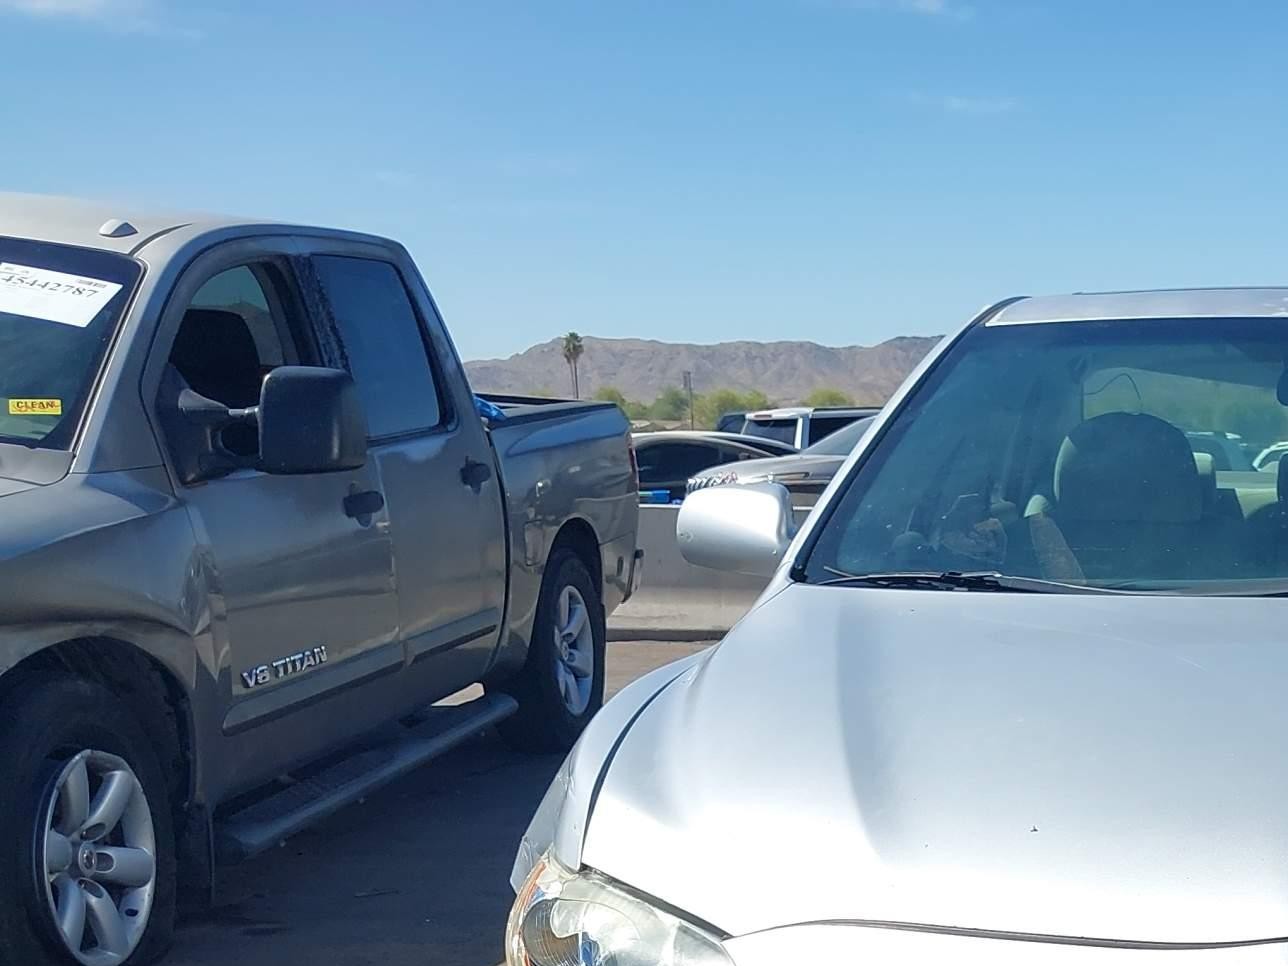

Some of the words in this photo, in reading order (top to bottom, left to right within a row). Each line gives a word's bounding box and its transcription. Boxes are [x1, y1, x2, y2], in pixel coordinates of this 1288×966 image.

[1, 275, 100, 298] 45442787
[16, 401, 54, 409] CLEAN
[272, 645, 328, 678] TITAN
